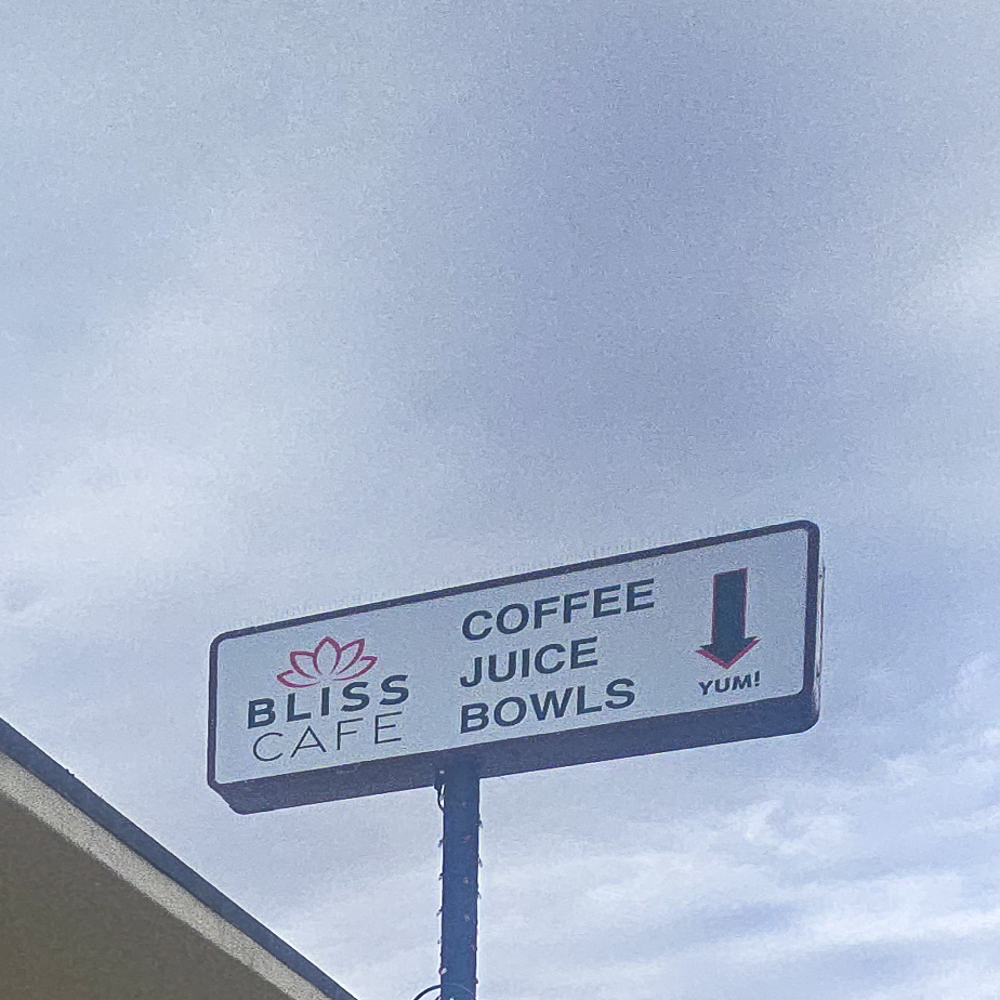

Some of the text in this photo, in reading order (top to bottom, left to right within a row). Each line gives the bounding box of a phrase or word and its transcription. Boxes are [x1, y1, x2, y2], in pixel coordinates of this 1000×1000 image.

[461, 578, 655, 641] COFFEE
[459, 635, 599, 689] JUICE
[697, 670, 762, 697] YUM!
[247, 674, 410, 730] BLISS
[460, 678, 637, 735] BOWLS
[252, 711, 404, 763] CAFE
